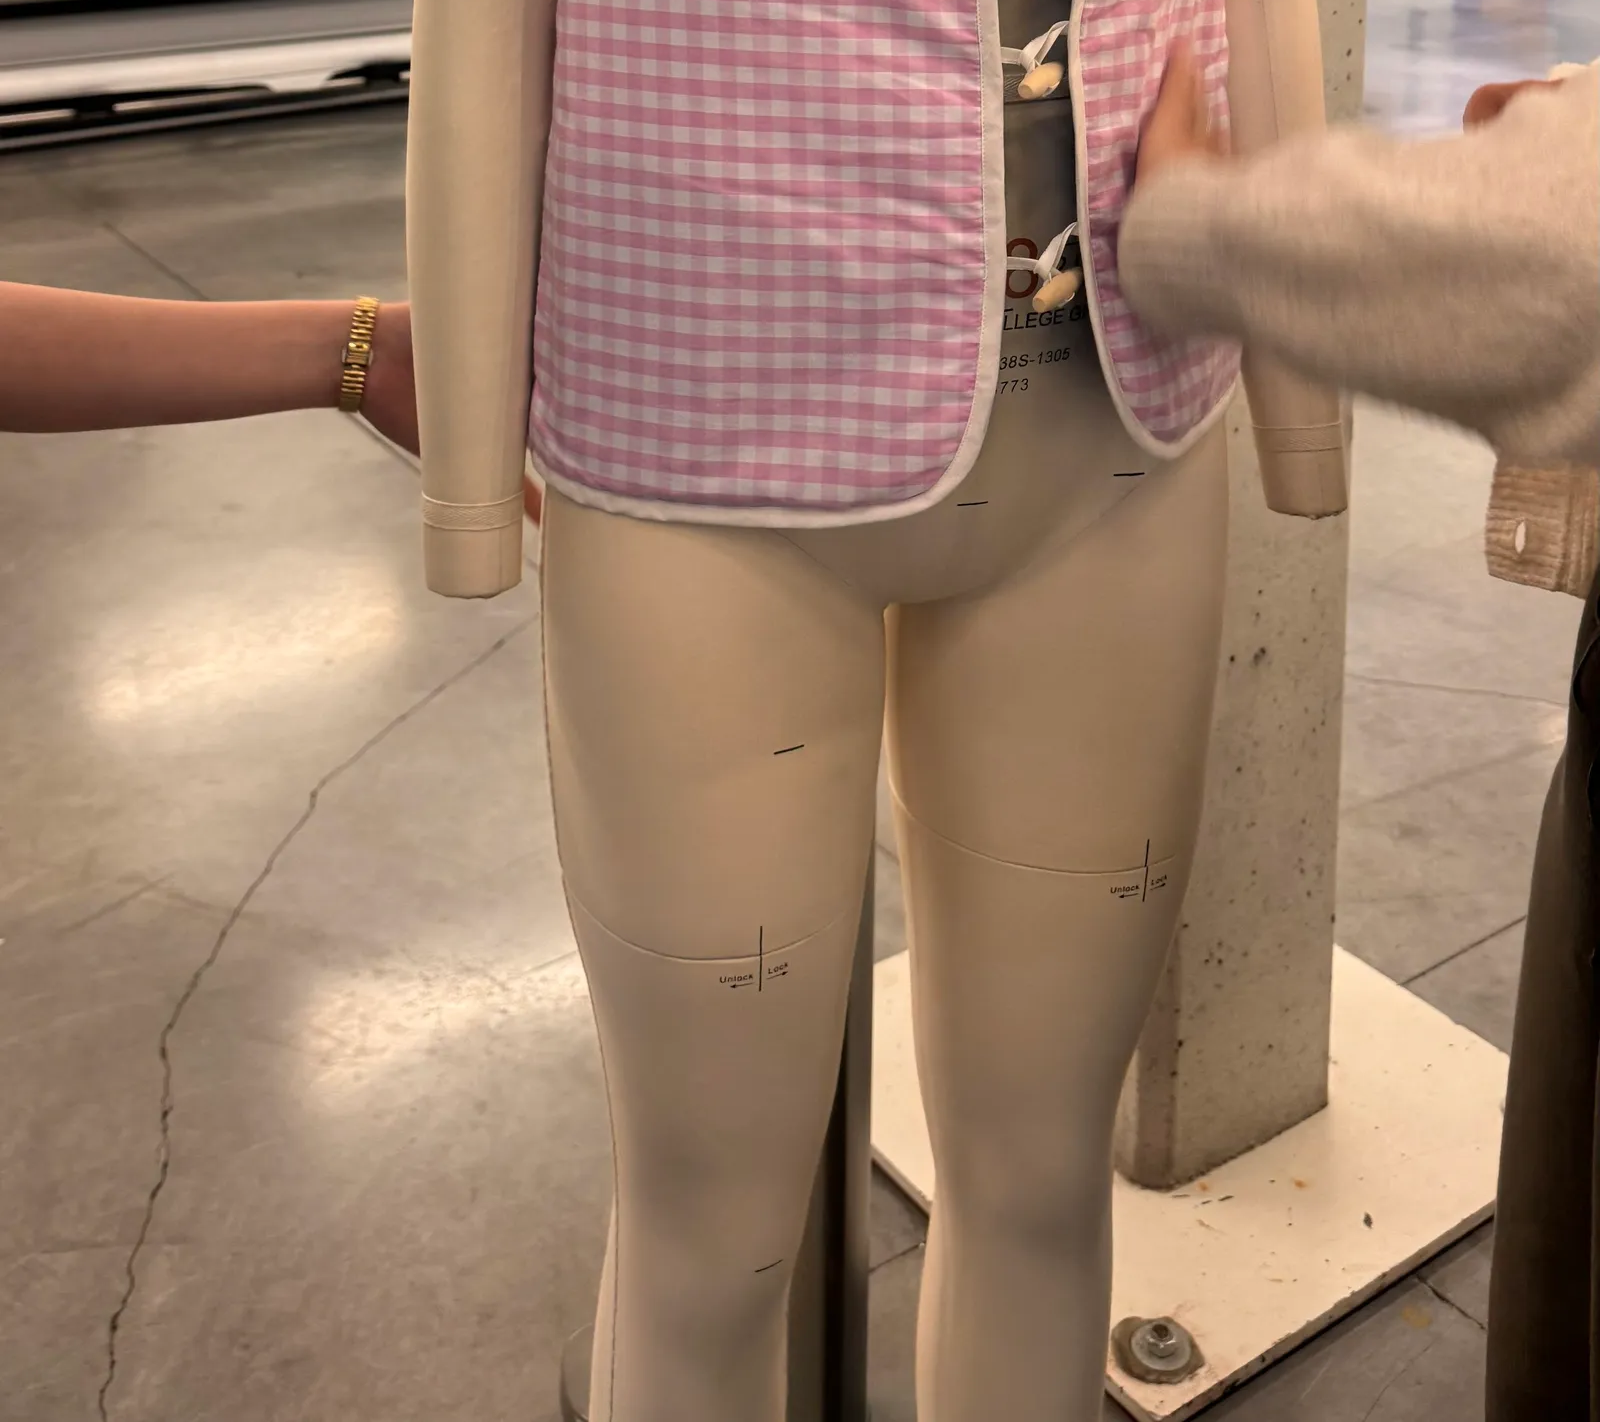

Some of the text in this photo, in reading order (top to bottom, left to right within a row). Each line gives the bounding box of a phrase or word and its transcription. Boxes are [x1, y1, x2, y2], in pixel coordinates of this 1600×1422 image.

[996, 378, 1030, 395] 773
[1109, 884, 1140, 894] Unlock
[767, 962, 789, 975] Lock
